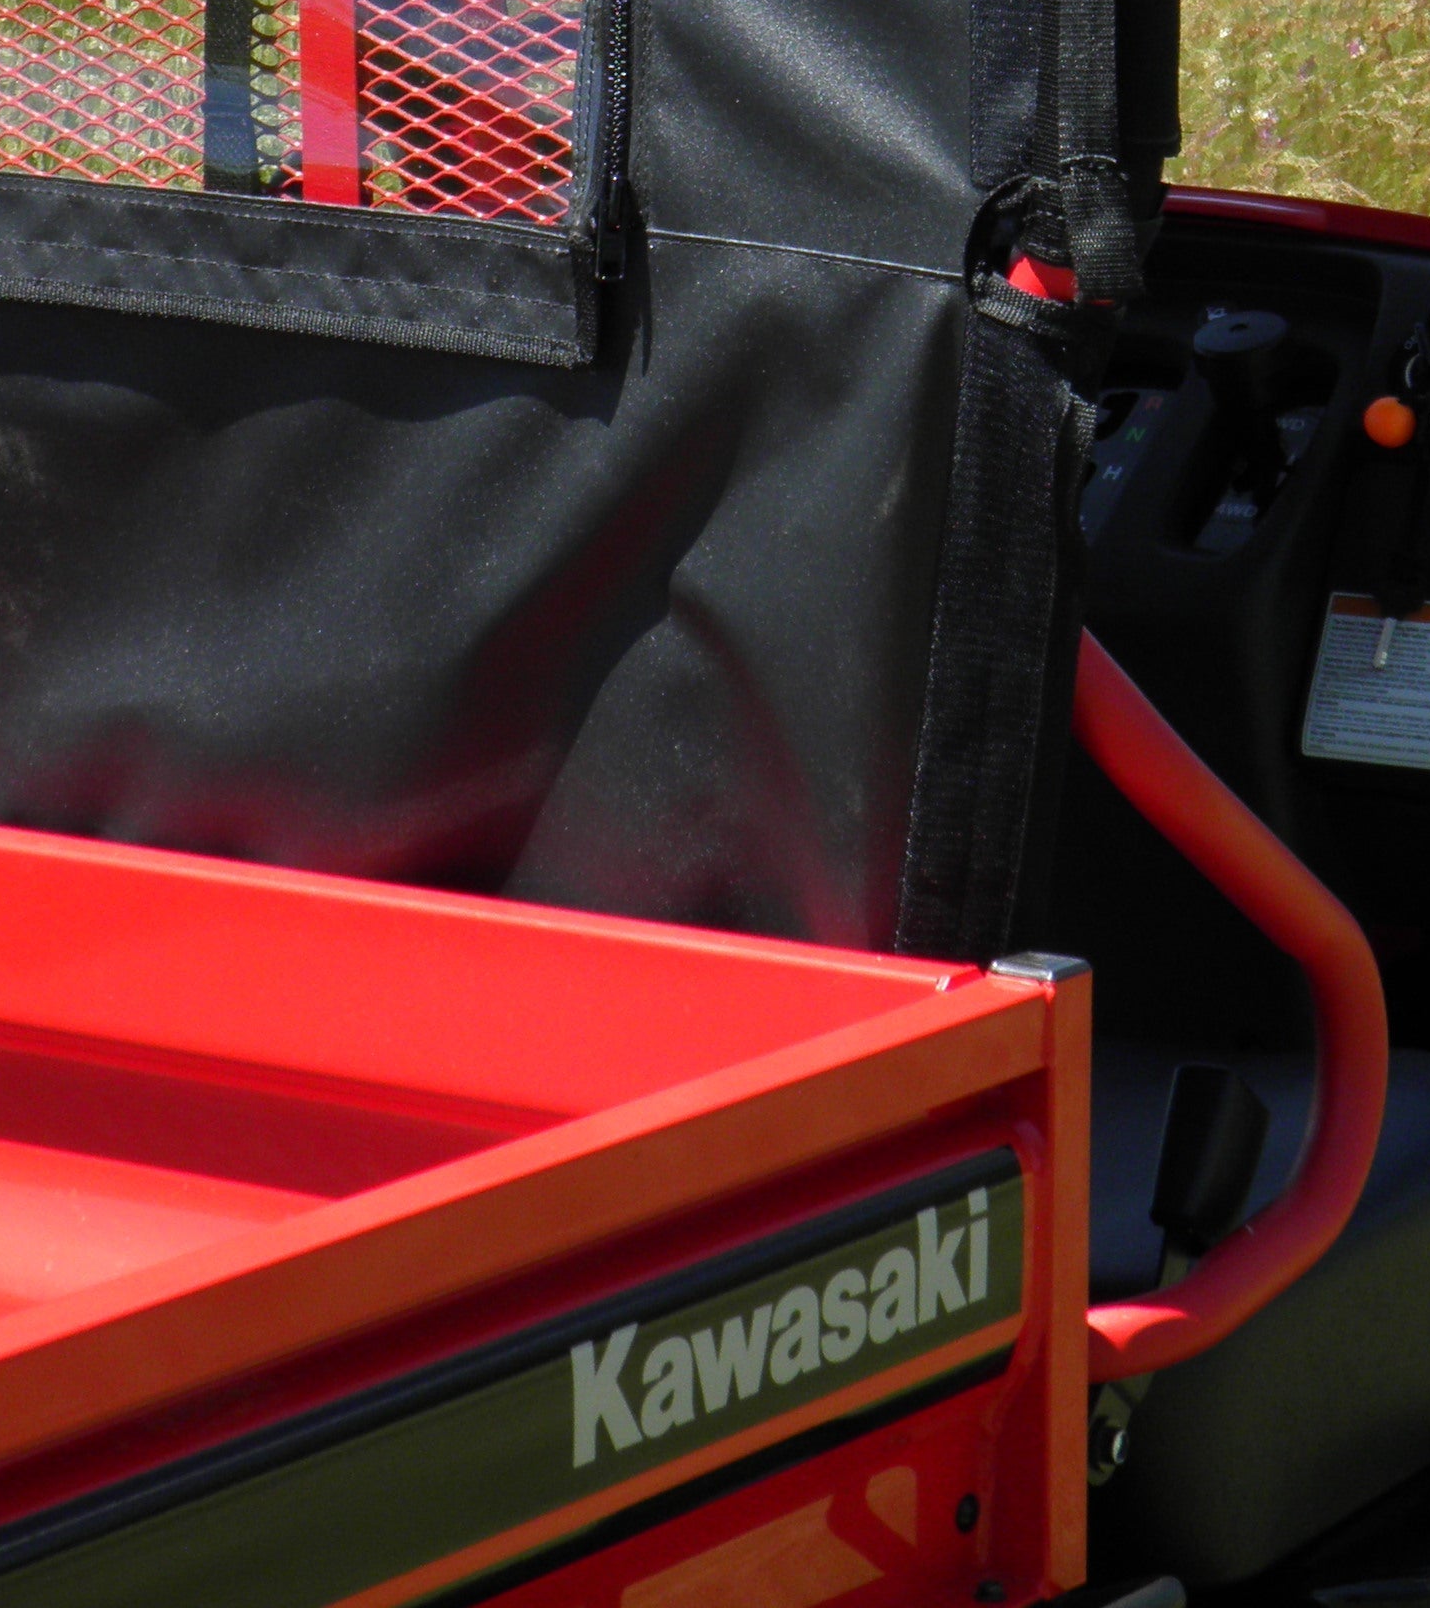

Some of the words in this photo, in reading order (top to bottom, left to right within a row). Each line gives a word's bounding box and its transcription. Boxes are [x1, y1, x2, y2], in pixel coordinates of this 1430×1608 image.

[1125, 427, 1146, 442] N
[1102, 465, 1122, 480] H
[571, 1187, 989, 1470] Kawasaki
